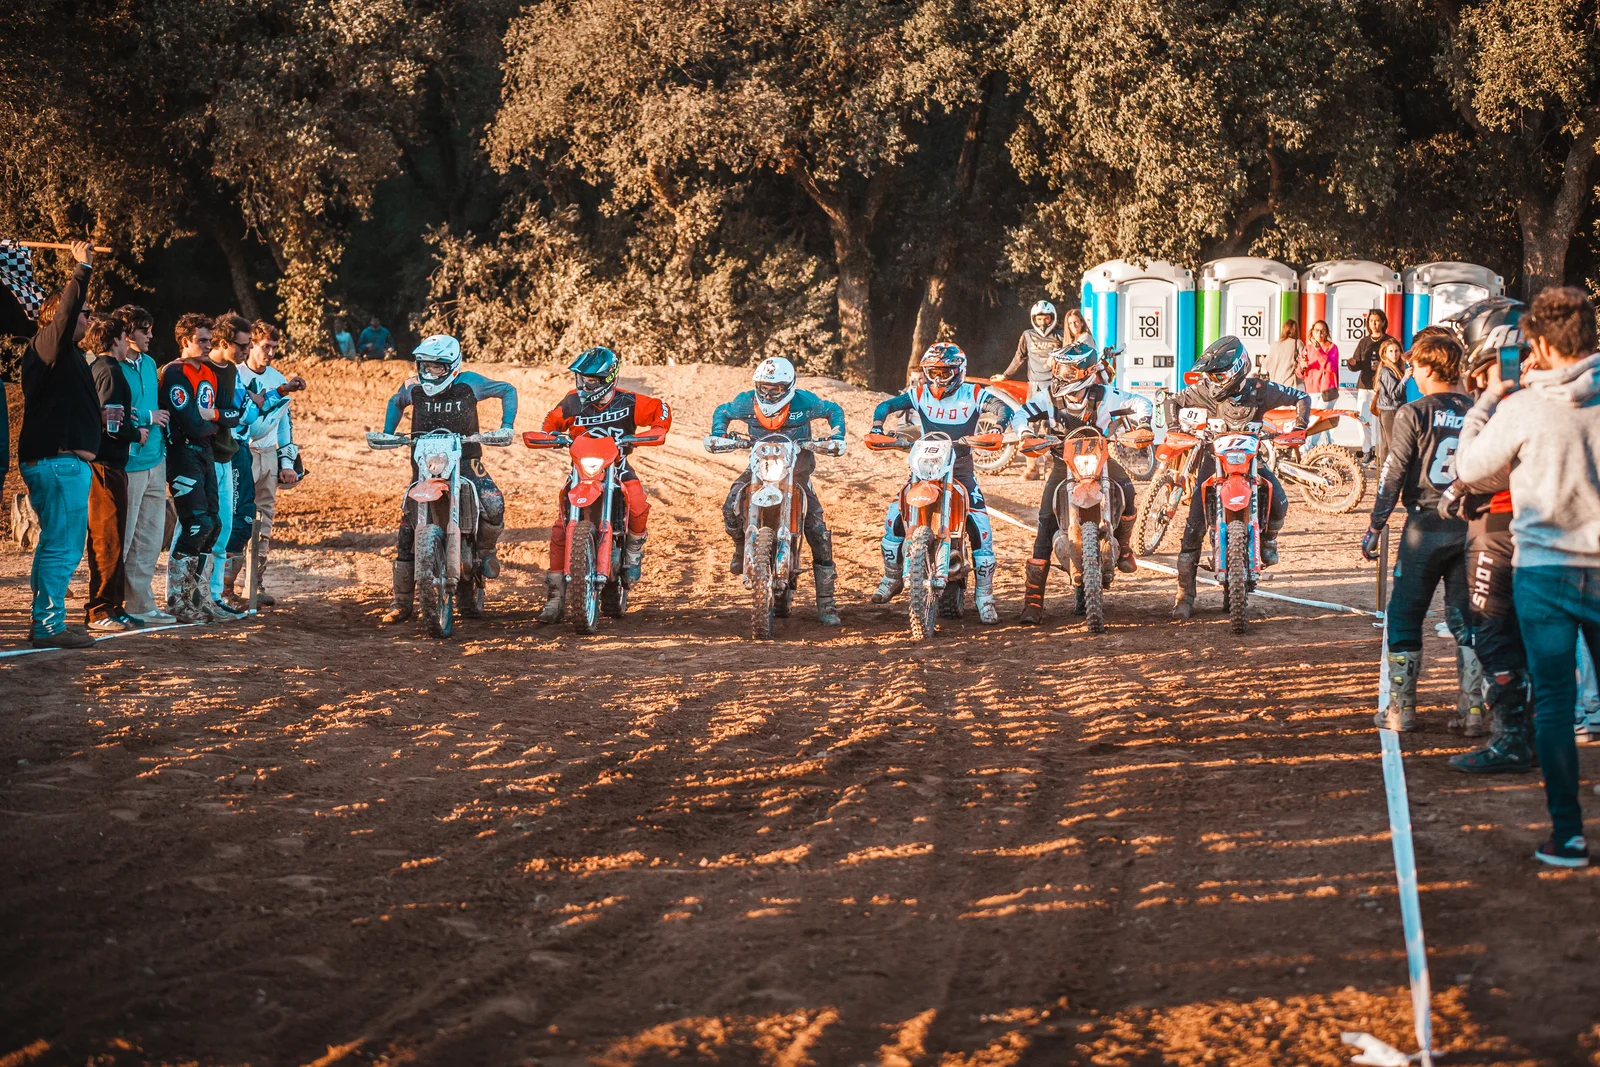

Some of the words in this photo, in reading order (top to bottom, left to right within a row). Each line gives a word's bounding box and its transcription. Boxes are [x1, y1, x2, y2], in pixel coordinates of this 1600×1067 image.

[1138, 316, 1158, 326] TOI
[1242, 316, 1262, 326] TOI
[1346, 318, 1366, 328] TOI
[1138, 327, 1158, 338] TOI
[1242, 326, 1261, 336] TOI
[425, 402, 461, 412] THOR
[574, 407, 630, 426] hebo
[926, 406, 968, 420] THOR
[1186, 410, 1198, 420] 81
[1228, 437, 1247, 448] 17
[1472, 552, 1494, 610] SHOT
